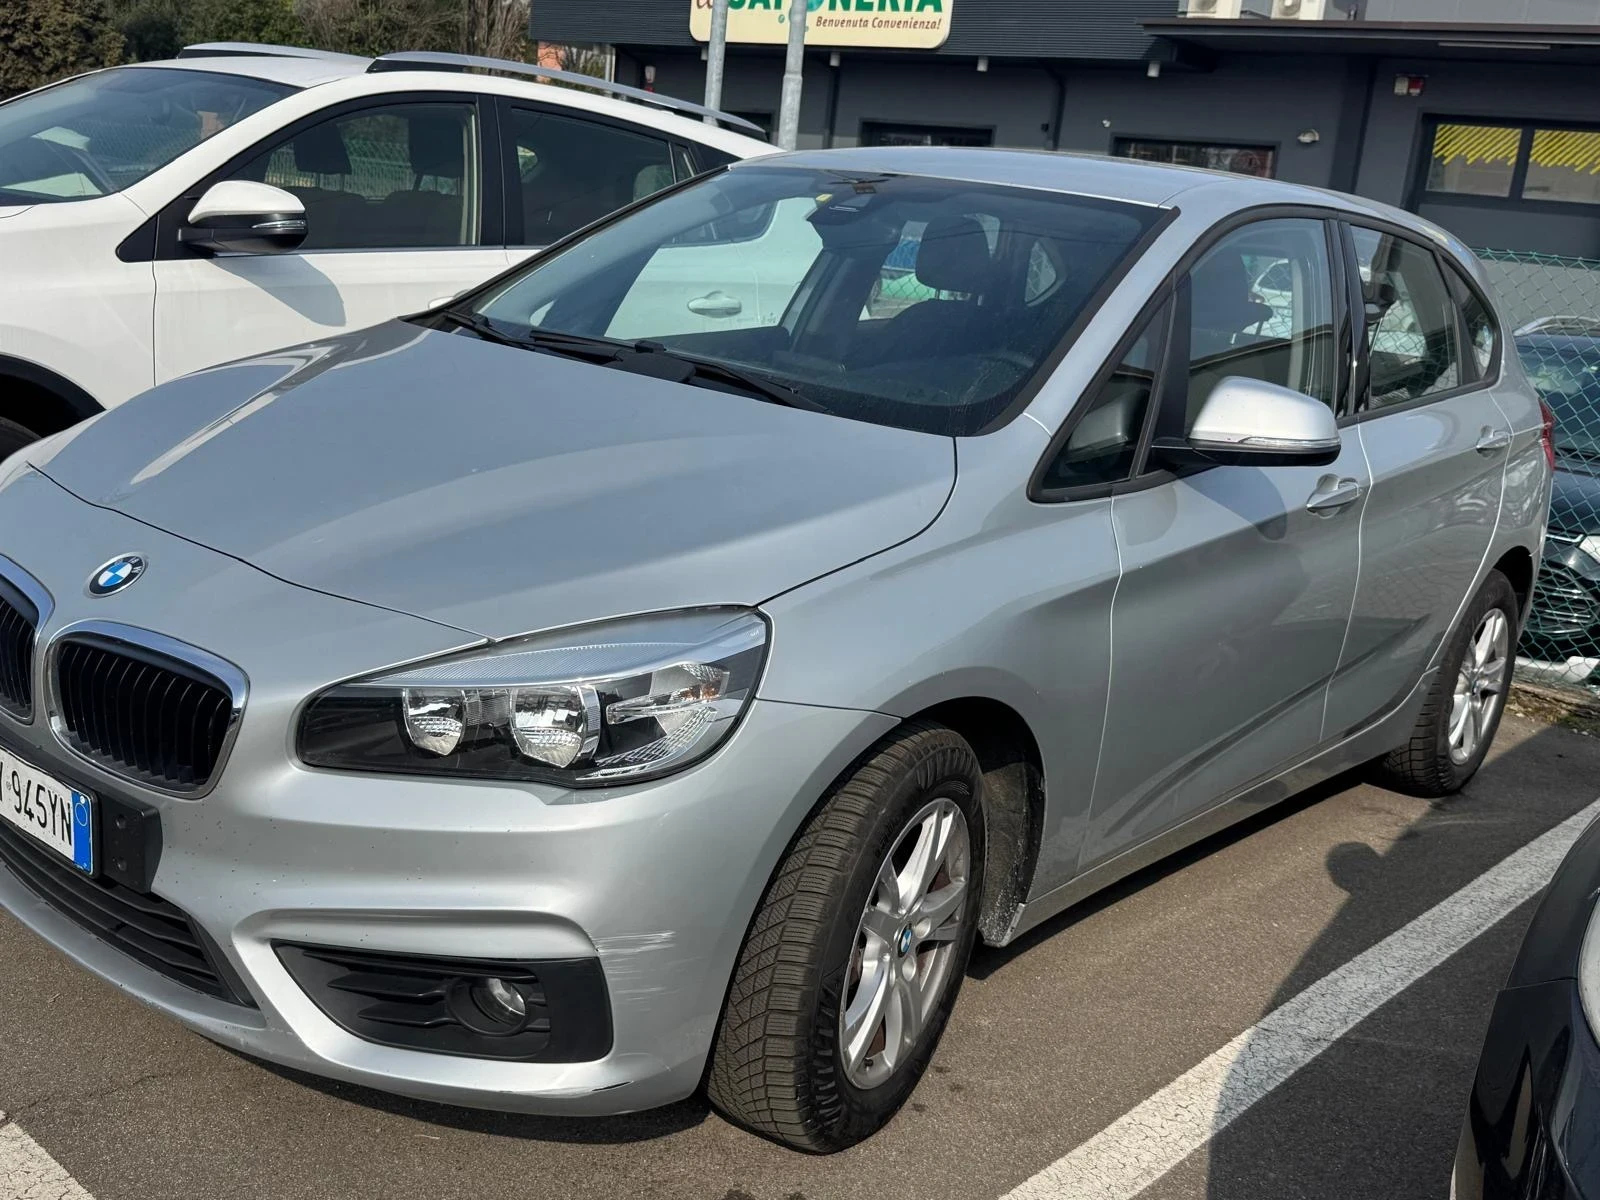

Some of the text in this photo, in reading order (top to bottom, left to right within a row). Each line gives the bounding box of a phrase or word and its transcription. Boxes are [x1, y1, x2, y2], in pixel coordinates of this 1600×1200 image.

[816, 16, 942, 30] Benvenuta Convenienza!
[12, 770, 72, 846] 945YN
